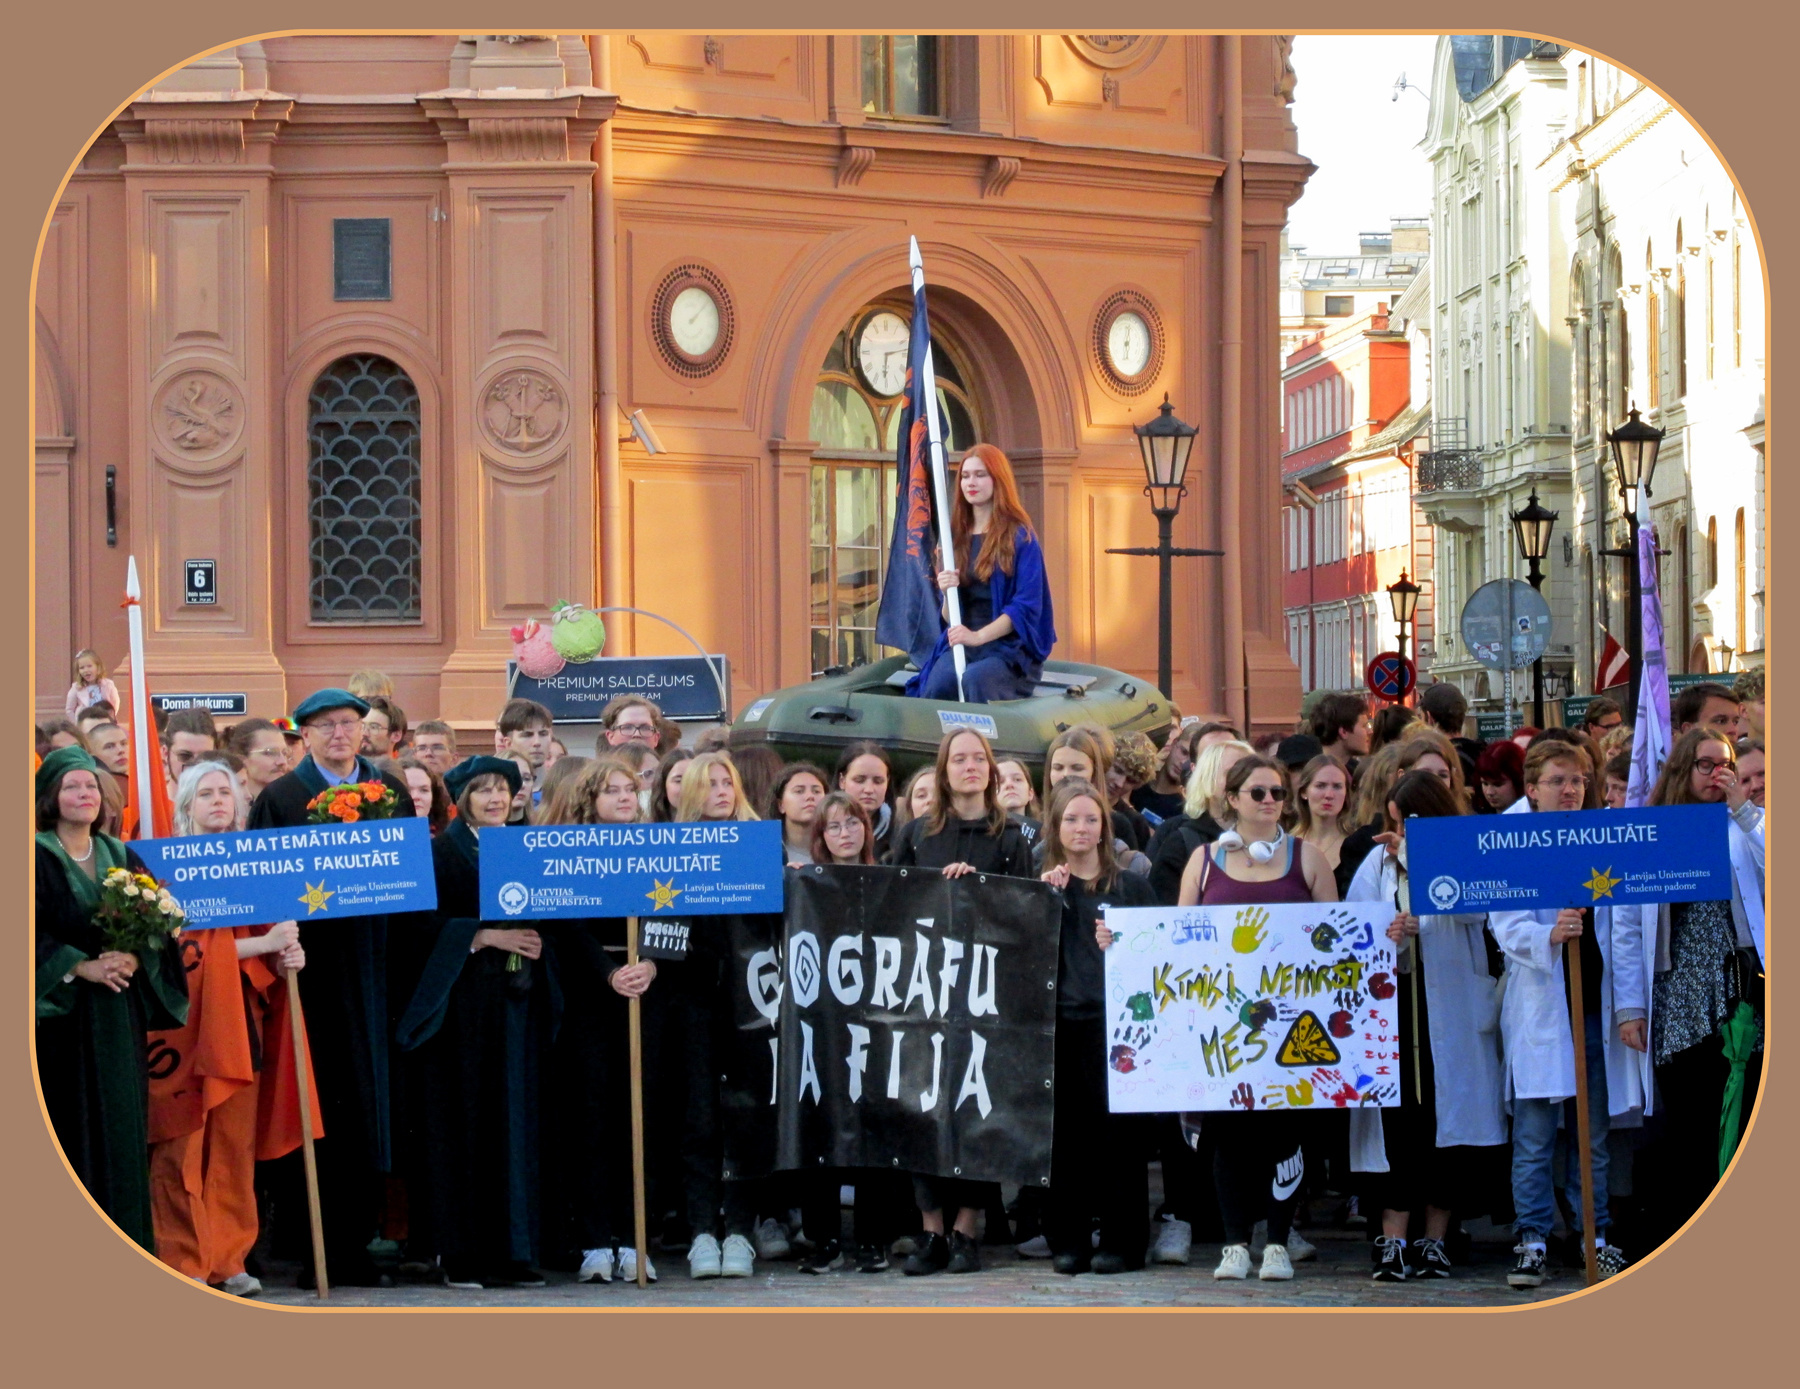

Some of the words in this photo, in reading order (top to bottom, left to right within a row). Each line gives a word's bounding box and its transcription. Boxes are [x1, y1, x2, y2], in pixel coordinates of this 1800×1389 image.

[194, 569, 206, 588] 6
[538, 676, 604, 689] PREMIUM
[608, 673, 695, 688] SALDĒJUMS
[162, 698, 191, 710] Doma
[193, 697, 234, 709] laukums
[565, 693, 608, 702] PREMIUM
[941, 712, 992, 726] DULKAN
[161, 840, 232, 860] FIZIKAS,
[236, 827, 371, 853] MATEMĀTIKAS
[379, 827, 405, 842] UN
[523, 828, 645, 852] ĢEOGRĀFIJAS
[650, 828, 676, 845] UN
[681, 826, 739, 844] ZEMES
[1477, 829, 1553, 855] ĶĪMIJAS
[1557, 823, 1658, 847] FAKULTĀTE
[174, 858, 304, 882] OPTOMETRIJAS
[314, 850, 400, 871] FAKULTĀTE
[543, 857, 622, 879] ZINĀTŅU
[627, 854, 721, 875] FAKULTĀTE
[1624, 871, 1657, 882] Latvijas
[1658, 869, 1711, 879] Universitātes
[337, 884, 367, 894] Latvijas
[368, 881, 418, 891] Universitātes
[684, 883, 714, 894] Latvijas
[716, 882, 766, 891] Universitātes
[1462, 879, 1508, 890] LATVIJAS
[1625, 883, 1662, 893] Studentu
[1664, 881, 1697, 894] padome
[338, 895, 373, 905] Studentu
[375, 892, 405, 904] padome
[530, 888, 574, 896] LATVIJAS
[183, 897, 227, 909] LATVIJAS
[684, 894, 720, 904] Studentu
[721, 893, 752, 905] padome
